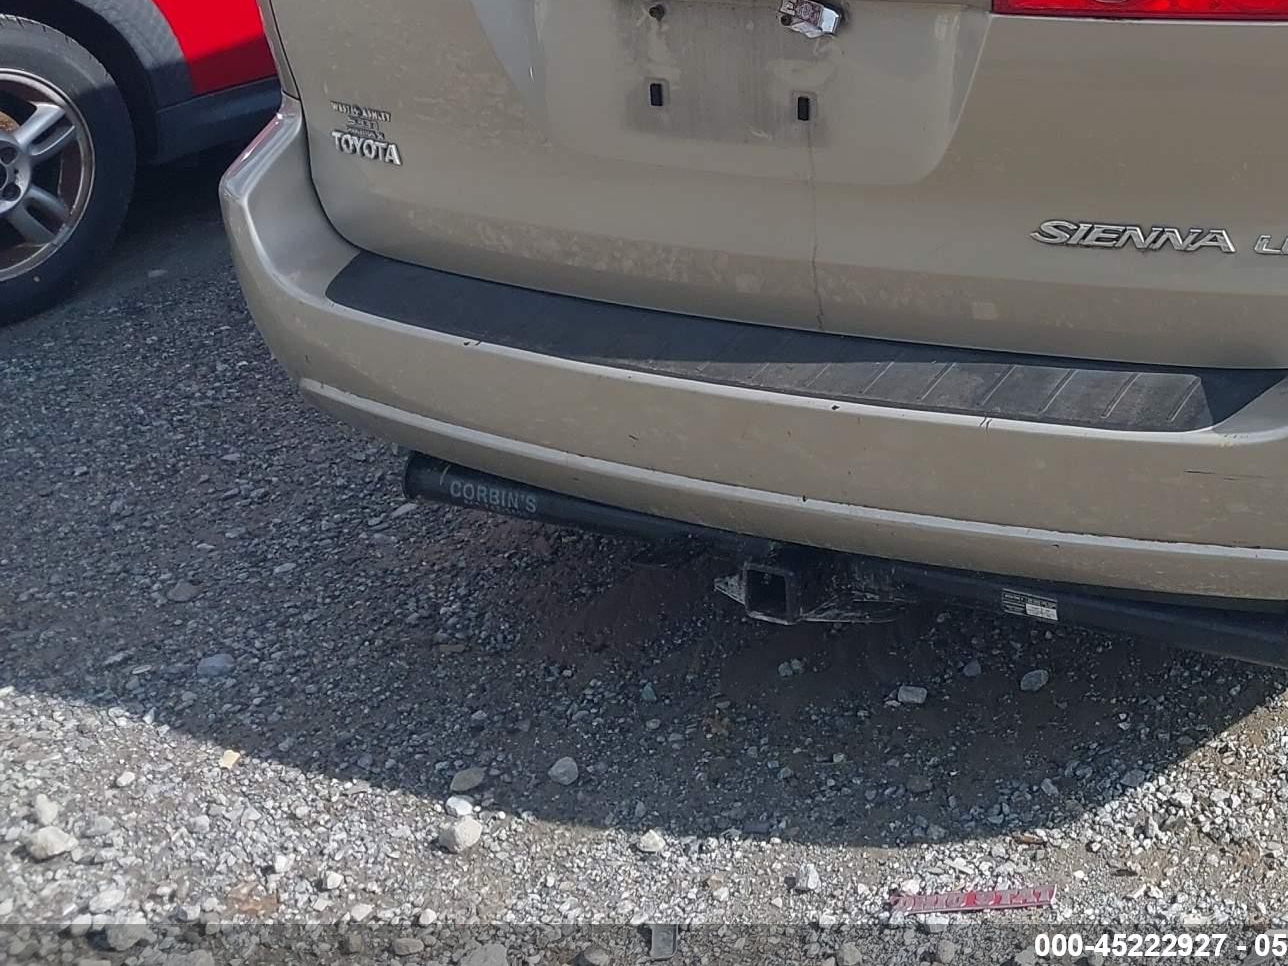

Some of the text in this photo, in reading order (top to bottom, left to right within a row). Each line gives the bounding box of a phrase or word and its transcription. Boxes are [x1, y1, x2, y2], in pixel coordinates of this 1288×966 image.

[331, 130, 402, 165] TOYOTA
[1030, 220, 1236, 253] SIENNA
[450, 480, 538, 513] CORBIN'S
